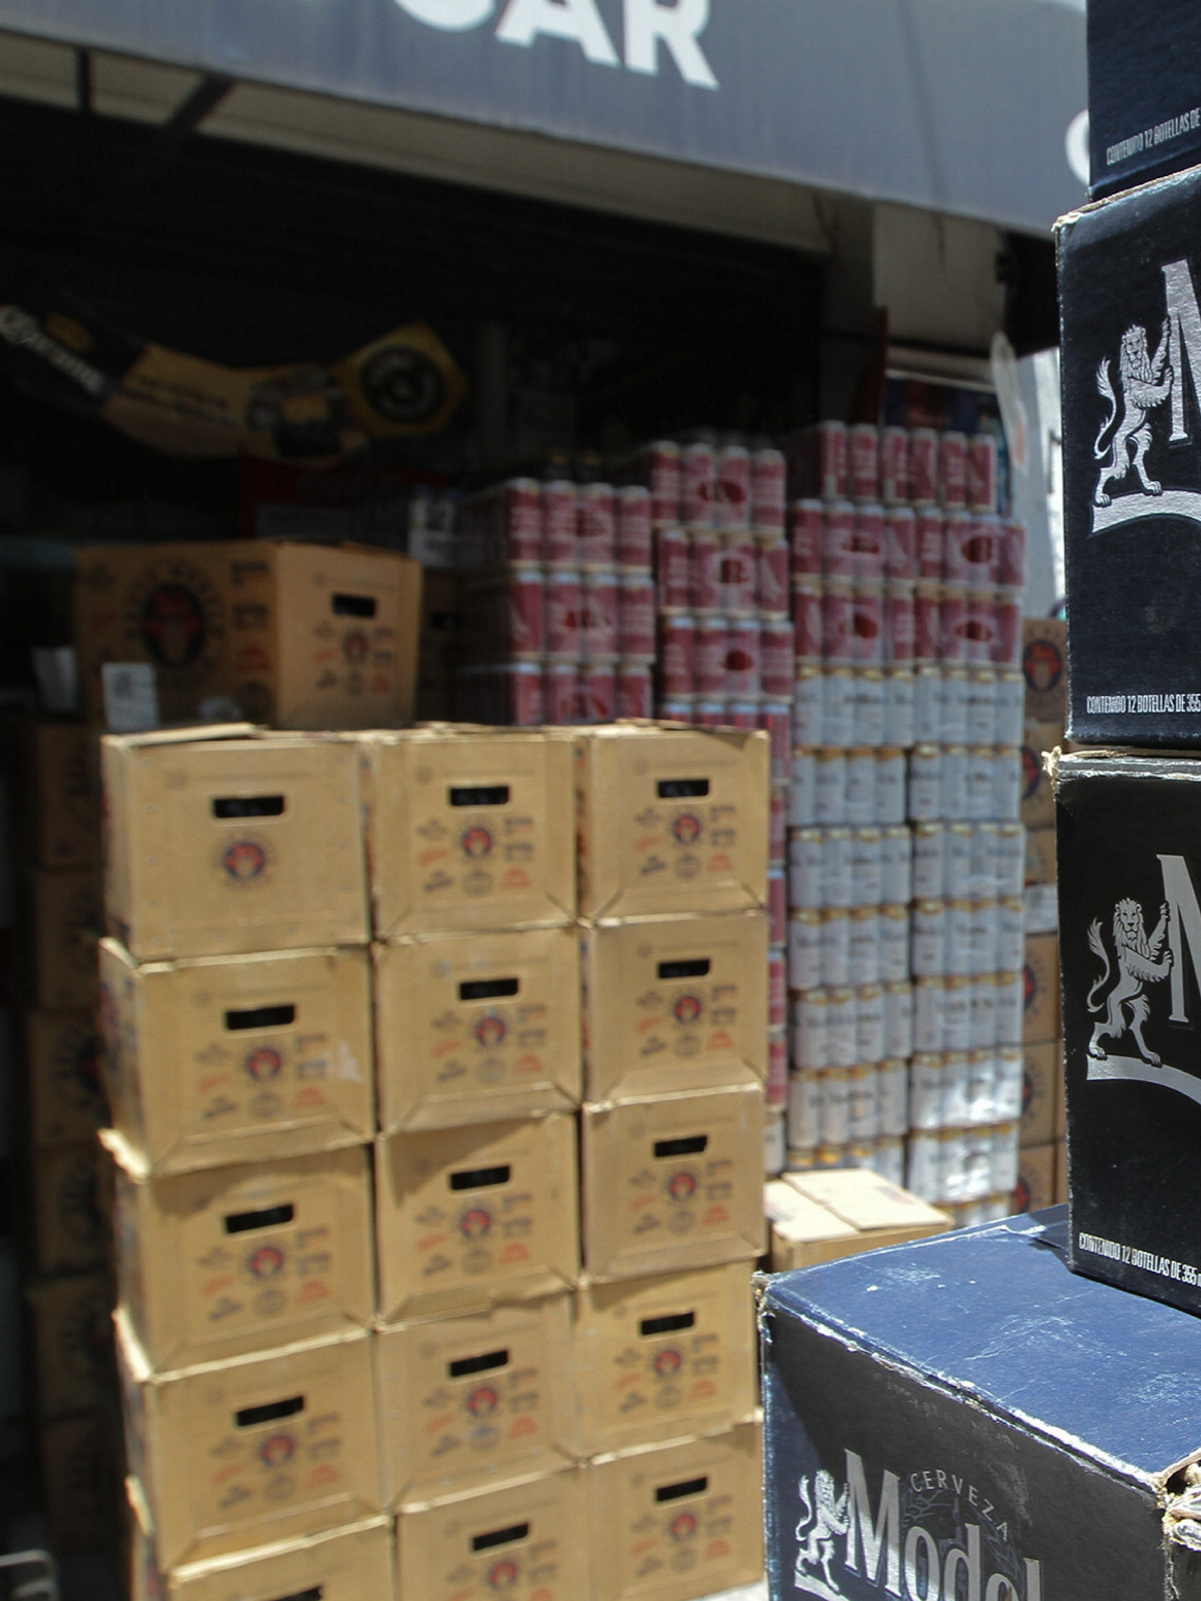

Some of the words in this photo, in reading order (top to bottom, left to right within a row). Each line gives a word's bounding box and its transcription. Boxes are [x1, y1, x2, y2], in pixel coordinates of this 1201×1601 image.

[1190, 106, 1200, 128] DE
[1127, 696, 1136, 713] 12
[1137, 694, 1175, 713] BOTELLAS
[1176, 693, 1186, 712] DE
[1186, 693, 1201, 712] 355
[1079, 1232, 1121, 1260] CONTENIDO
[1121, 1245, 1131, 1264] 12
[1131, 1249, 1170, 1277] BOTELLAS
[1171, 1260, 1182, 1281] DE
[1182, 1264, 1197, 1286] 355
[910, 1469, 1008, 1542] CERVEZA
